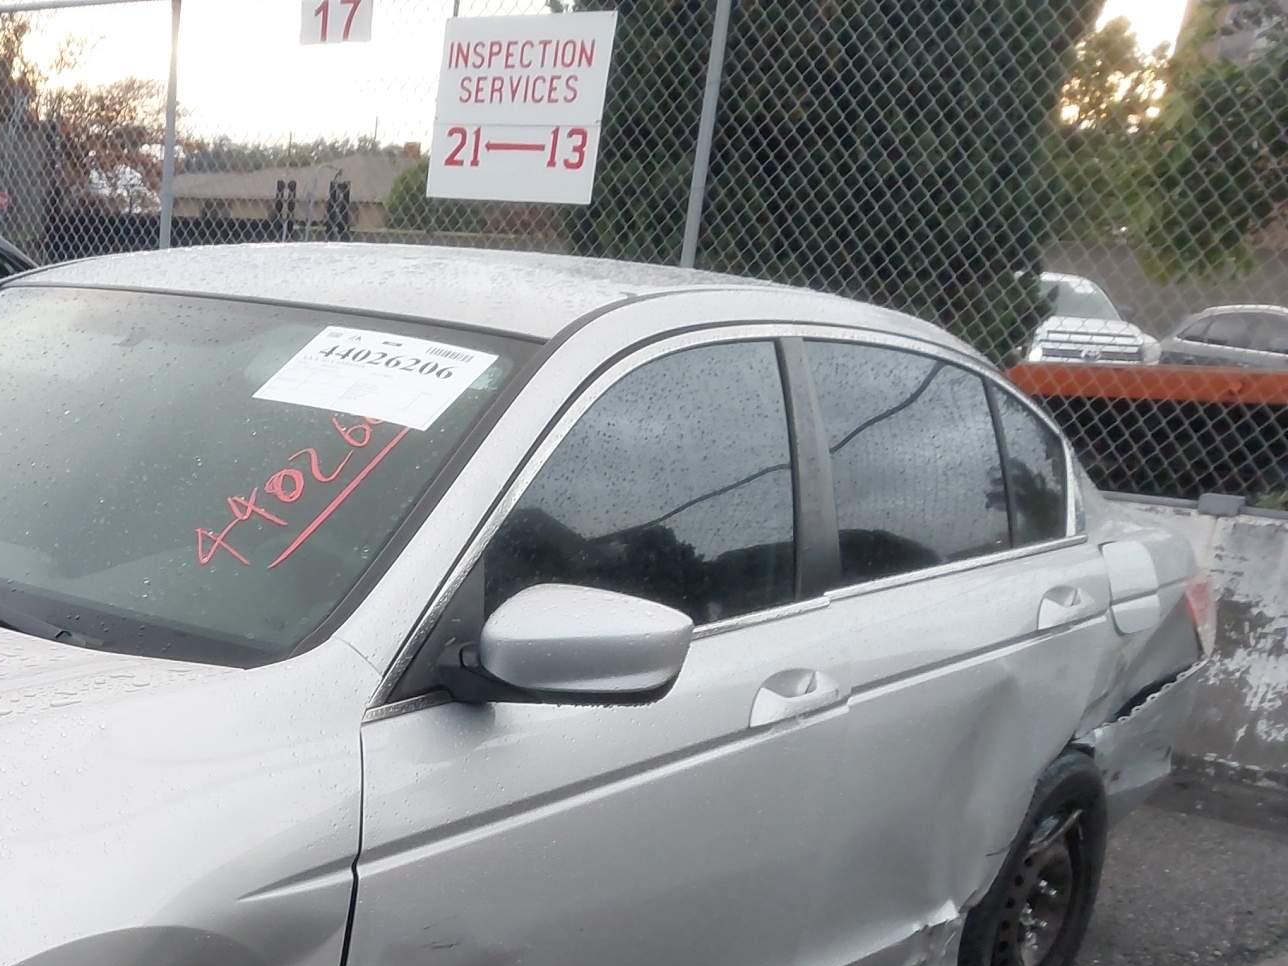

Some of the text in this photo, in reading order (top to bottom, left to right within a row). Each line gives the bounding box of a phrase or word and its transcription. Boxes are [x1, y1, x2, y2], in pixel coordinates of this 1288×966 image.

[314, 0, 361, 42] 17
[448, 39, 596, 69] INSPECTION
[459, 75, 579, 104] SERVICES
[319, 344, 458, 380] 44026206
[196, 415, 386, 564] 44026
